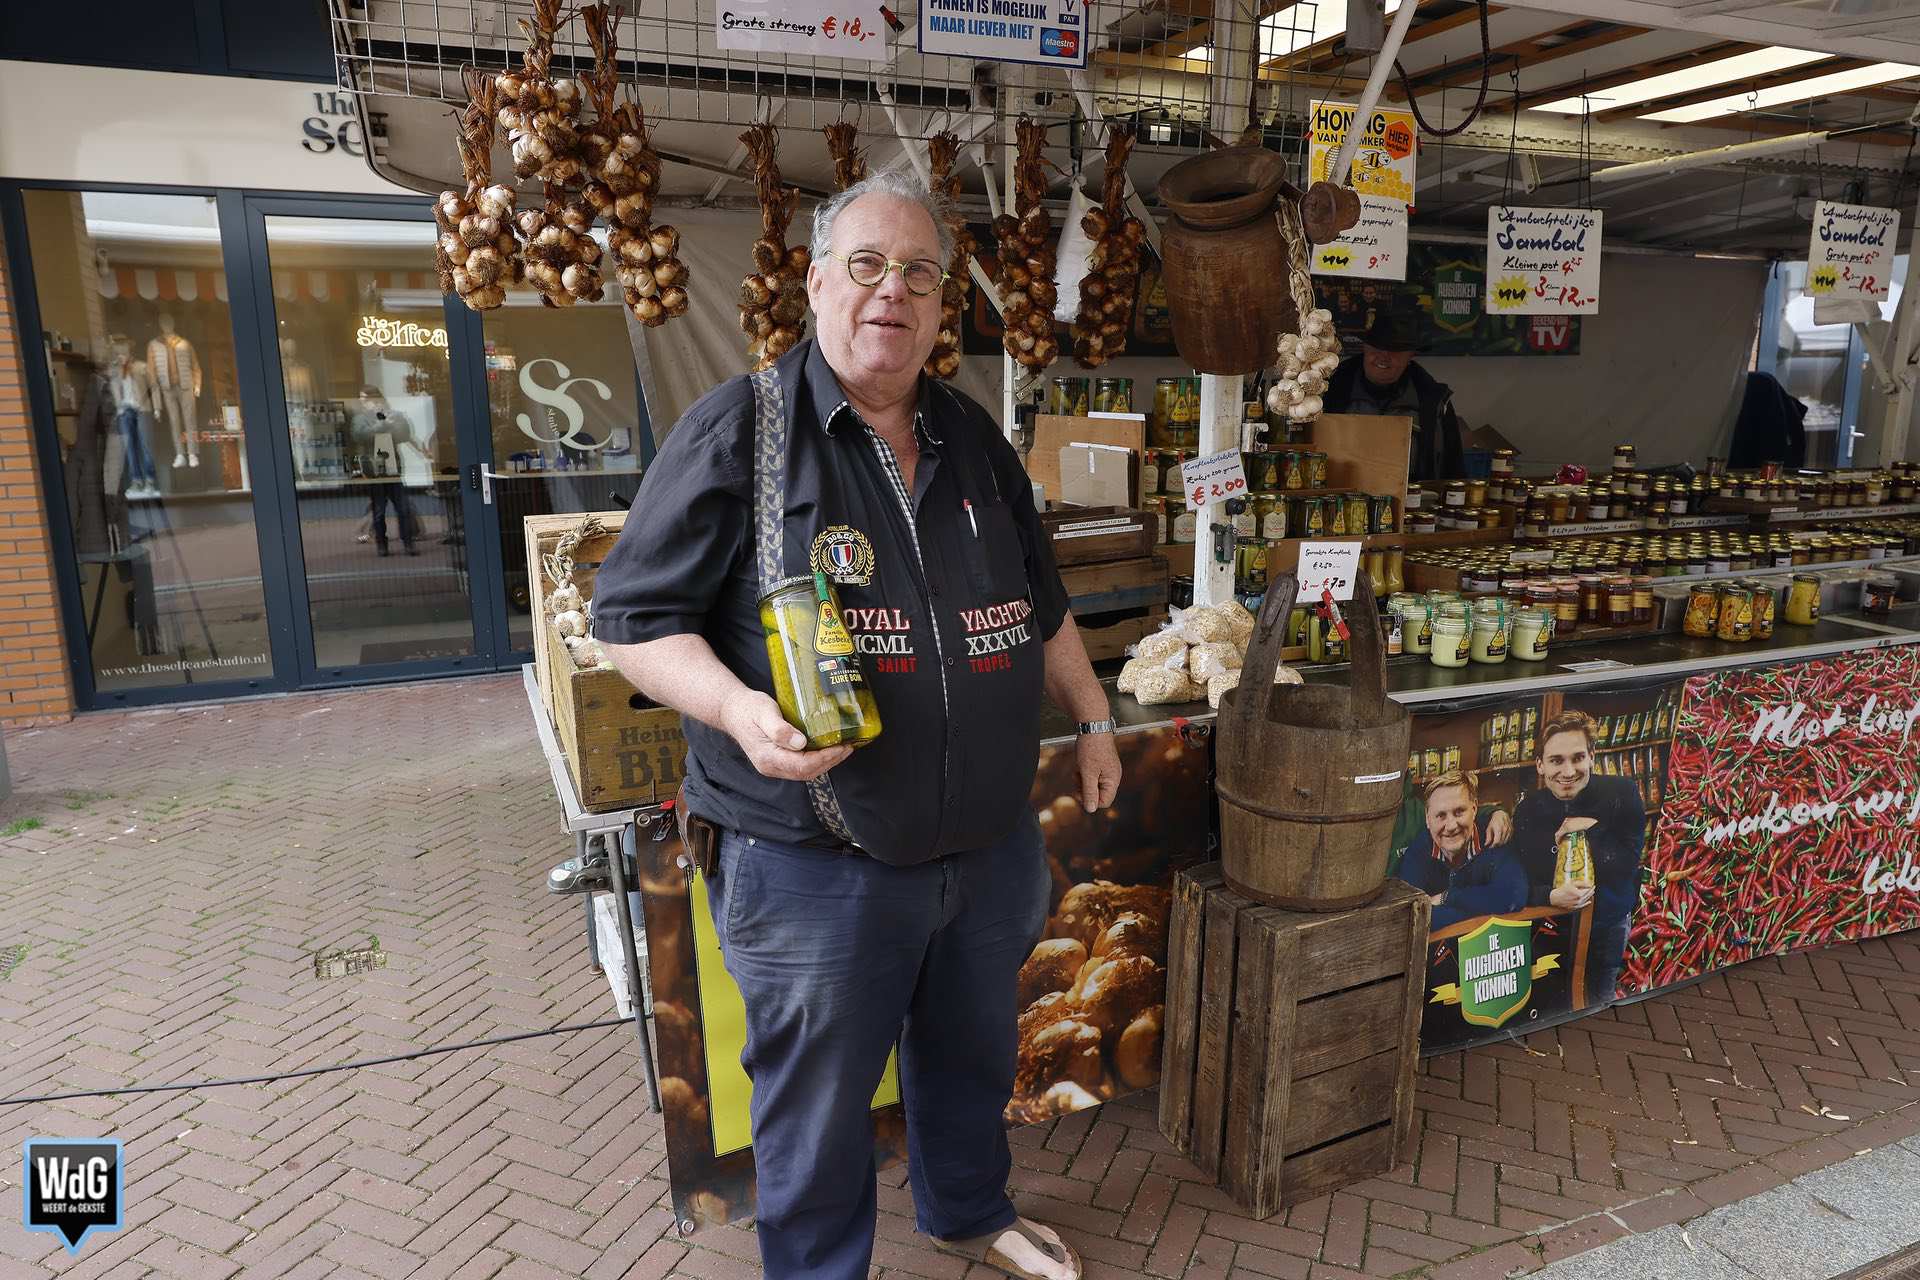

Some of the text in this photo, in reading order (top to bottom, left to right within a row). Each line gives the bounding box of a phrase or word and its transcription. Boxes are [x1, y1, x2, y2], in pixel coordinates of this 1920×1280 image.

[930, 0, 1047, 20] PINNEN IS MOGELIJK
[1063, 15, 1076, 23] PAY
[722, 11, 765, 30] Grote
[769, 18, 817, 37] streng
[930, 16, 1034, 40] MAAR LIEVER NIET
[1045, 37, 1075, 48] Maestro
[313, 91, 354, 115] th
[1317, 109, 1386, 134] HONG
[1317, 132, 1339, 143] VAN
[1359, 136, 1385, 147] MKER
[1389, 129, 1410, 145] HIER
[1497, 223, 1586, 251] Sambal
[1820, 218, 1886, 247] Sambal
[1503, 256, 1538, 269] Kleine
[1540, 259, 1559, 273] pot
[1438, 282, 1477, 299] AUGURKEN
[1498, 288, 1527, 301] nu
[1535, 275, 1547, 297] 3
[1442, 300, 1471, 315] KONING
[356, 320, 449, 347] selfca
[362, 316, 389, 329] the
[1533, 327, 1568, 346] TV
[1191, 486, 1206, 506] €
[844, 607, 911, 631] OYAL
[853, 623, 1031, 656] CML XXXVII
[877, 652, 1012, 673] SAINT TROPEZ
[619, 725, 684, 746] Hein
[1750, 702, 1846, 748] Met
[1704, 791, 1839, 846] maken
[1488, 932, 1500, 952] DE
[1464, 943, 1525, 981] AUGURKEN
[1474, 971, 1517, 1004] KONING
